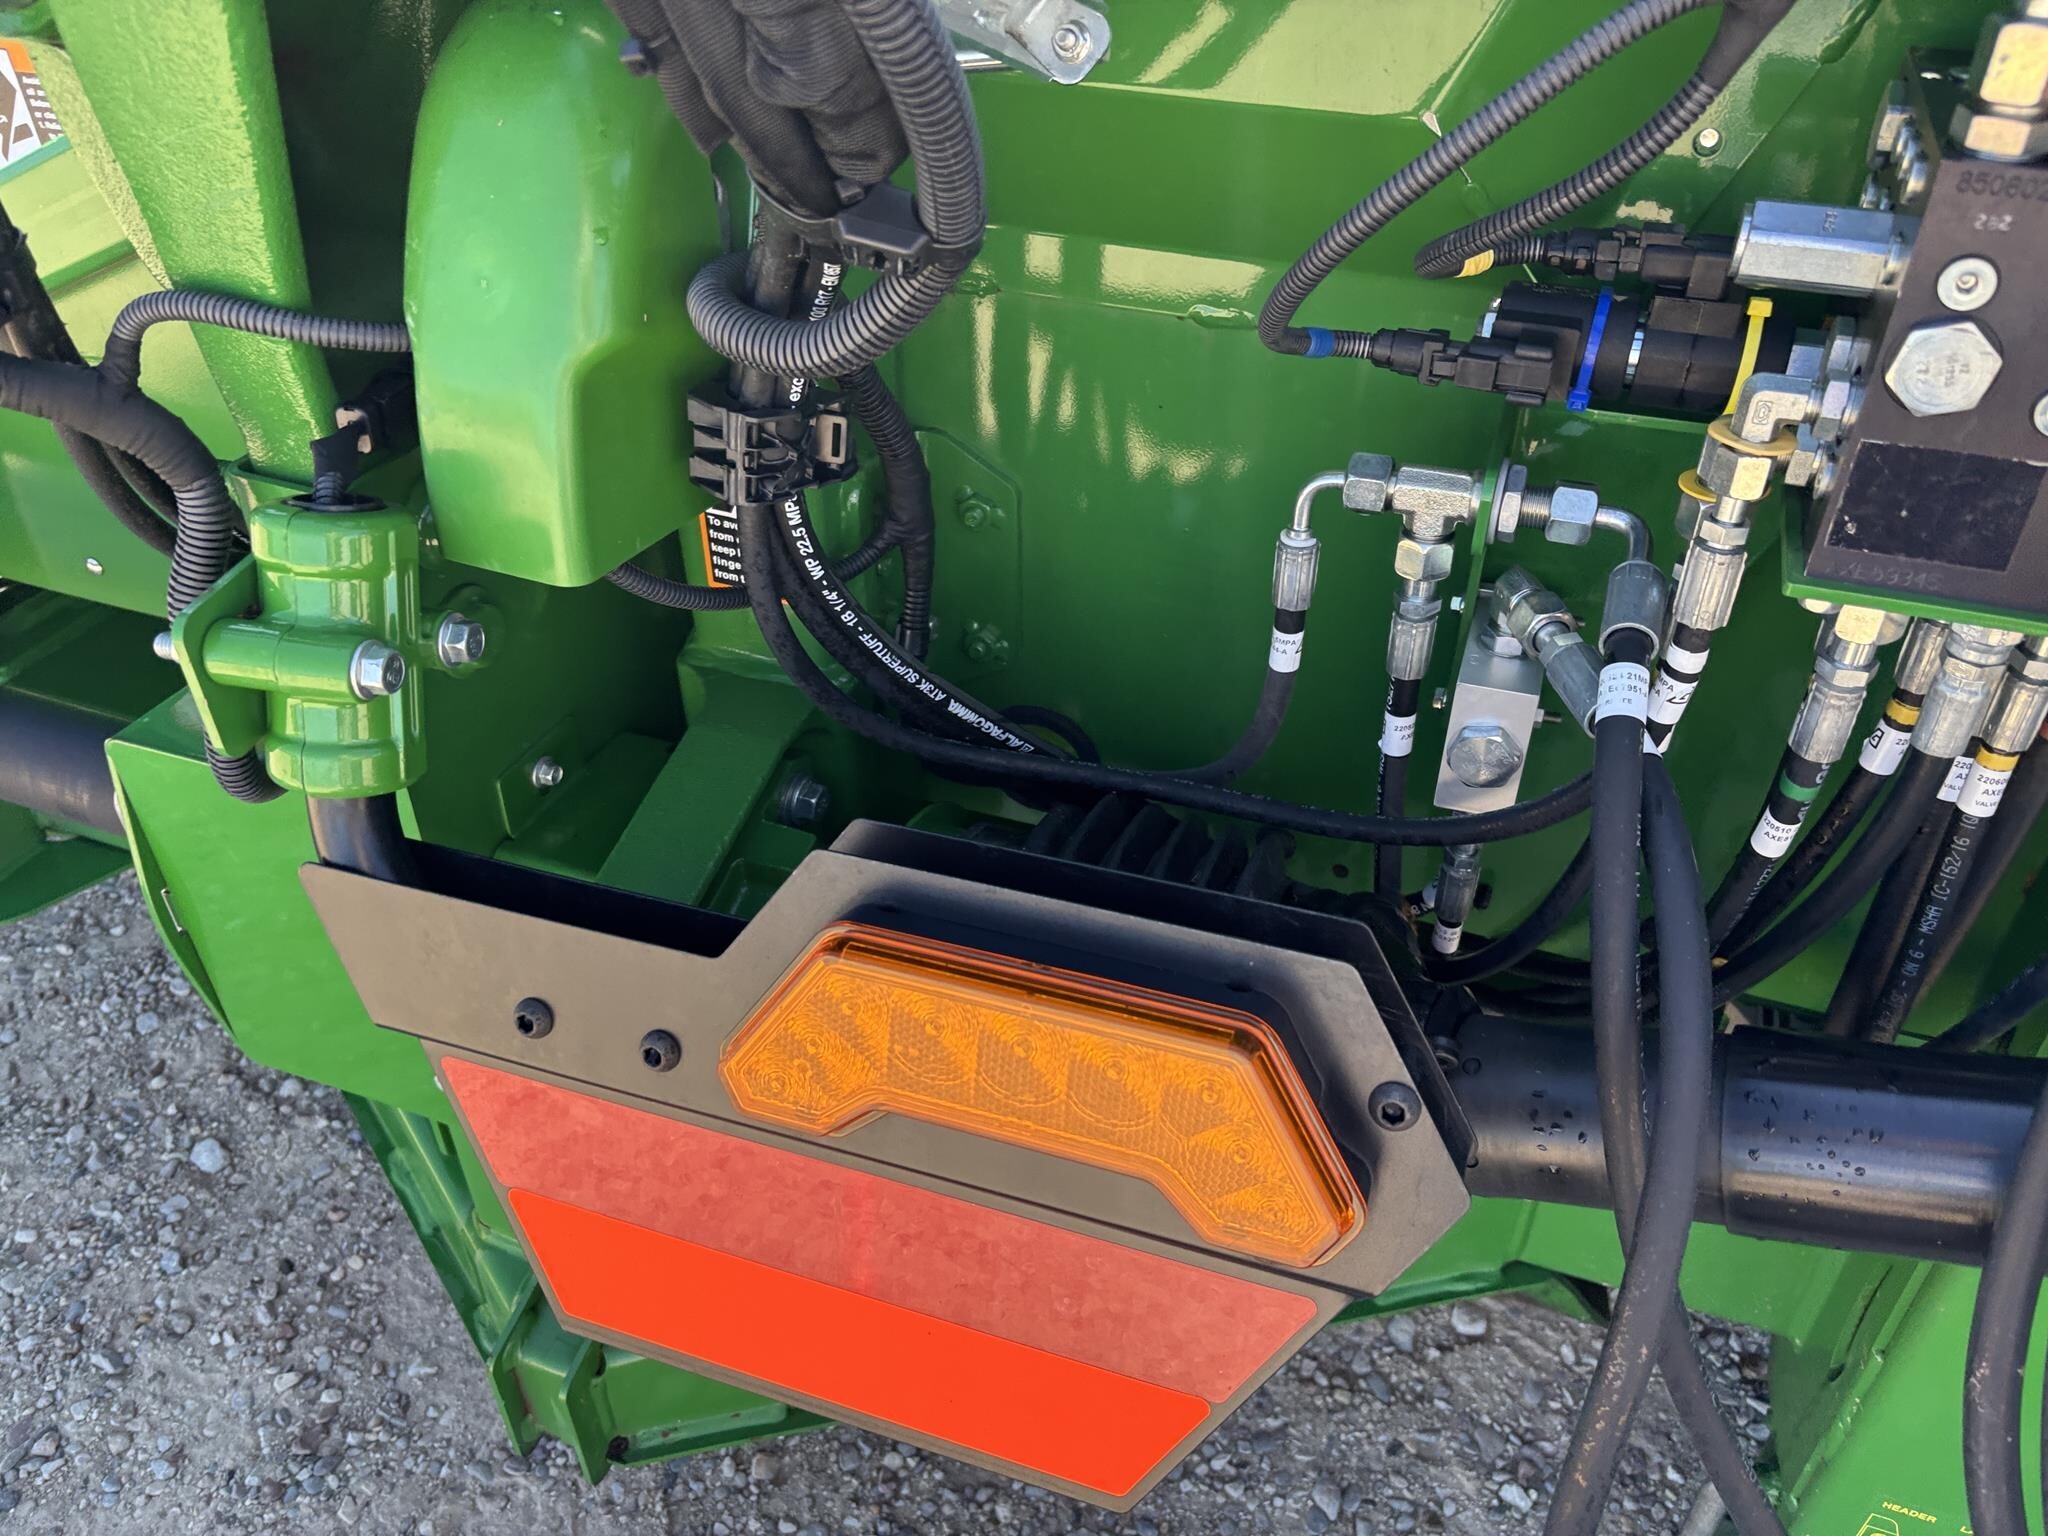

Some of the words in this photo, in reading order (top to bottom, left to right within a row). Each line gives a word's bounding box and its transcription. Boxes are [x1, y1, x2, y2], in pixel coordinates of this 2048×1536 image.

[814, 289, 834, 306] R17
[706, 515, 721, 527] To
[709, 529, 734, 542] from
[791, 526, 815, 556] 22.5
[711, 543, 736, 557] keep
[713, 555, 742, 570] finge
[804, 556, 824, 581] WP
[714, 568, 739, 582] from
[858, 633, 924, 685] SUPERTUFF
[915, 679, 947, 704] AT3K
[946, 698, 1026, 752] ALFAGOMMA
[1918, 904, 1943, 934] MSHA
[1882, 1500, 1937, 1524] HEADER
